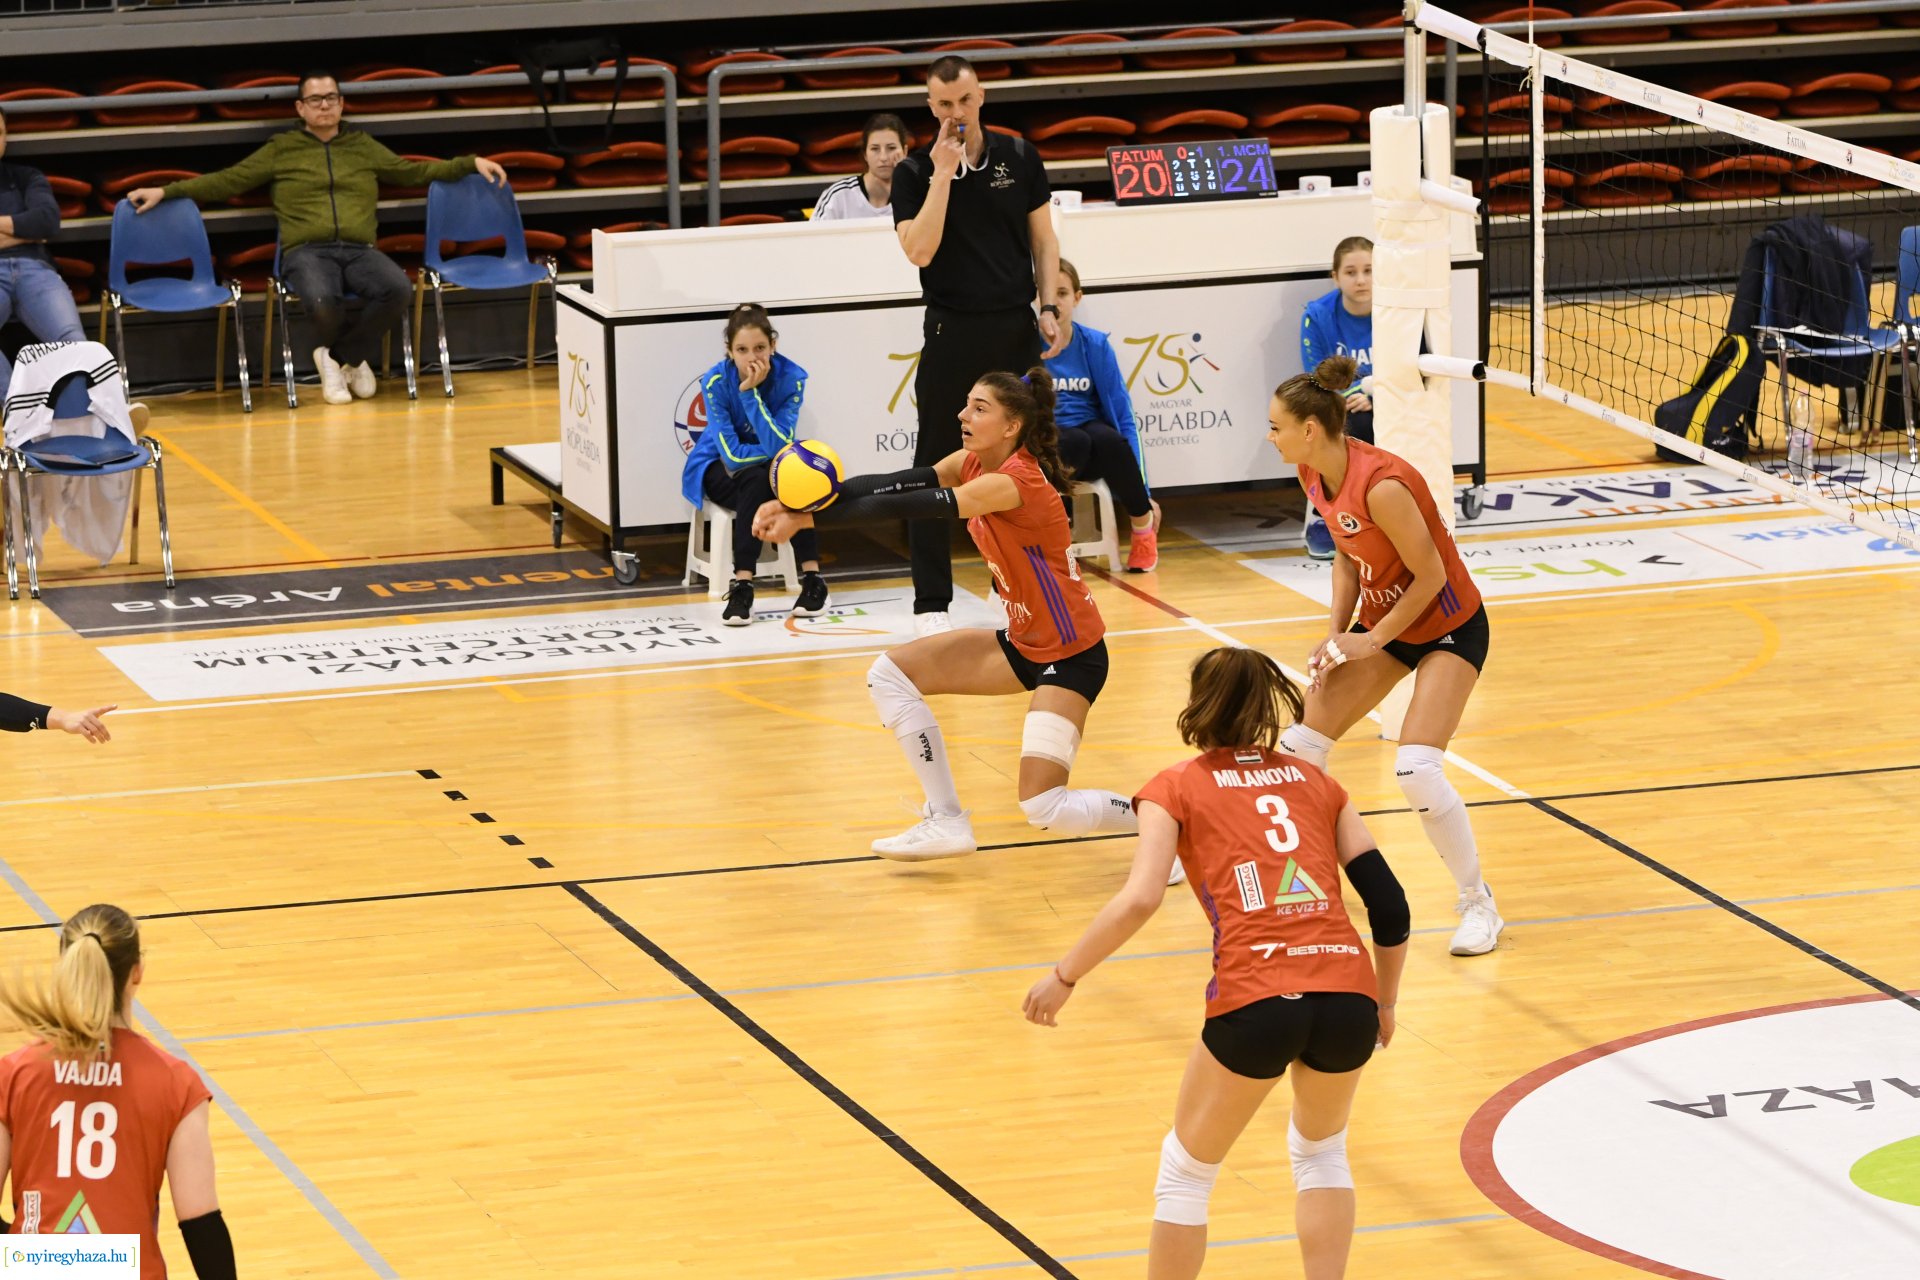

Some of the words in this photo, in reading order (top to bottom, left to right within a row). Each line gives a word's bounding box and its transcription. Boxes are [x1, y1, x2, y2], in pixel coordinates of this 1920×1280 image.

[1111, 149, 1164, 163] FATUM
[1233, 143, 1270, 157] MCM
[1116, 162, 1168, 198] 20
[1221, 156, 1271, 193] 24
[1051, 376, 1091, 391] JAKO
[1150, 399, 1192, 409] MAGYAR
[111, 586, 344, 613] Aréna
[192, 623, 703, 669] SPORTCENTRUM
[307, 635, 722, 675] NYÍREGYHÁZI
[1212, 765, 1307, 788] MILANOVA
[1255, 794, 1300, 853] 3
[1241, 865, 1259, 908] STRABAG
[1276, 902, 1315, 916] KE-VIZ
[1317, 901, 1329, 911] 21
[1286, 944, 1360, 957] BESTRONG
[54, 1059, 123, 1087] VAJDA
[50, 1100, 119, 1180] 18
